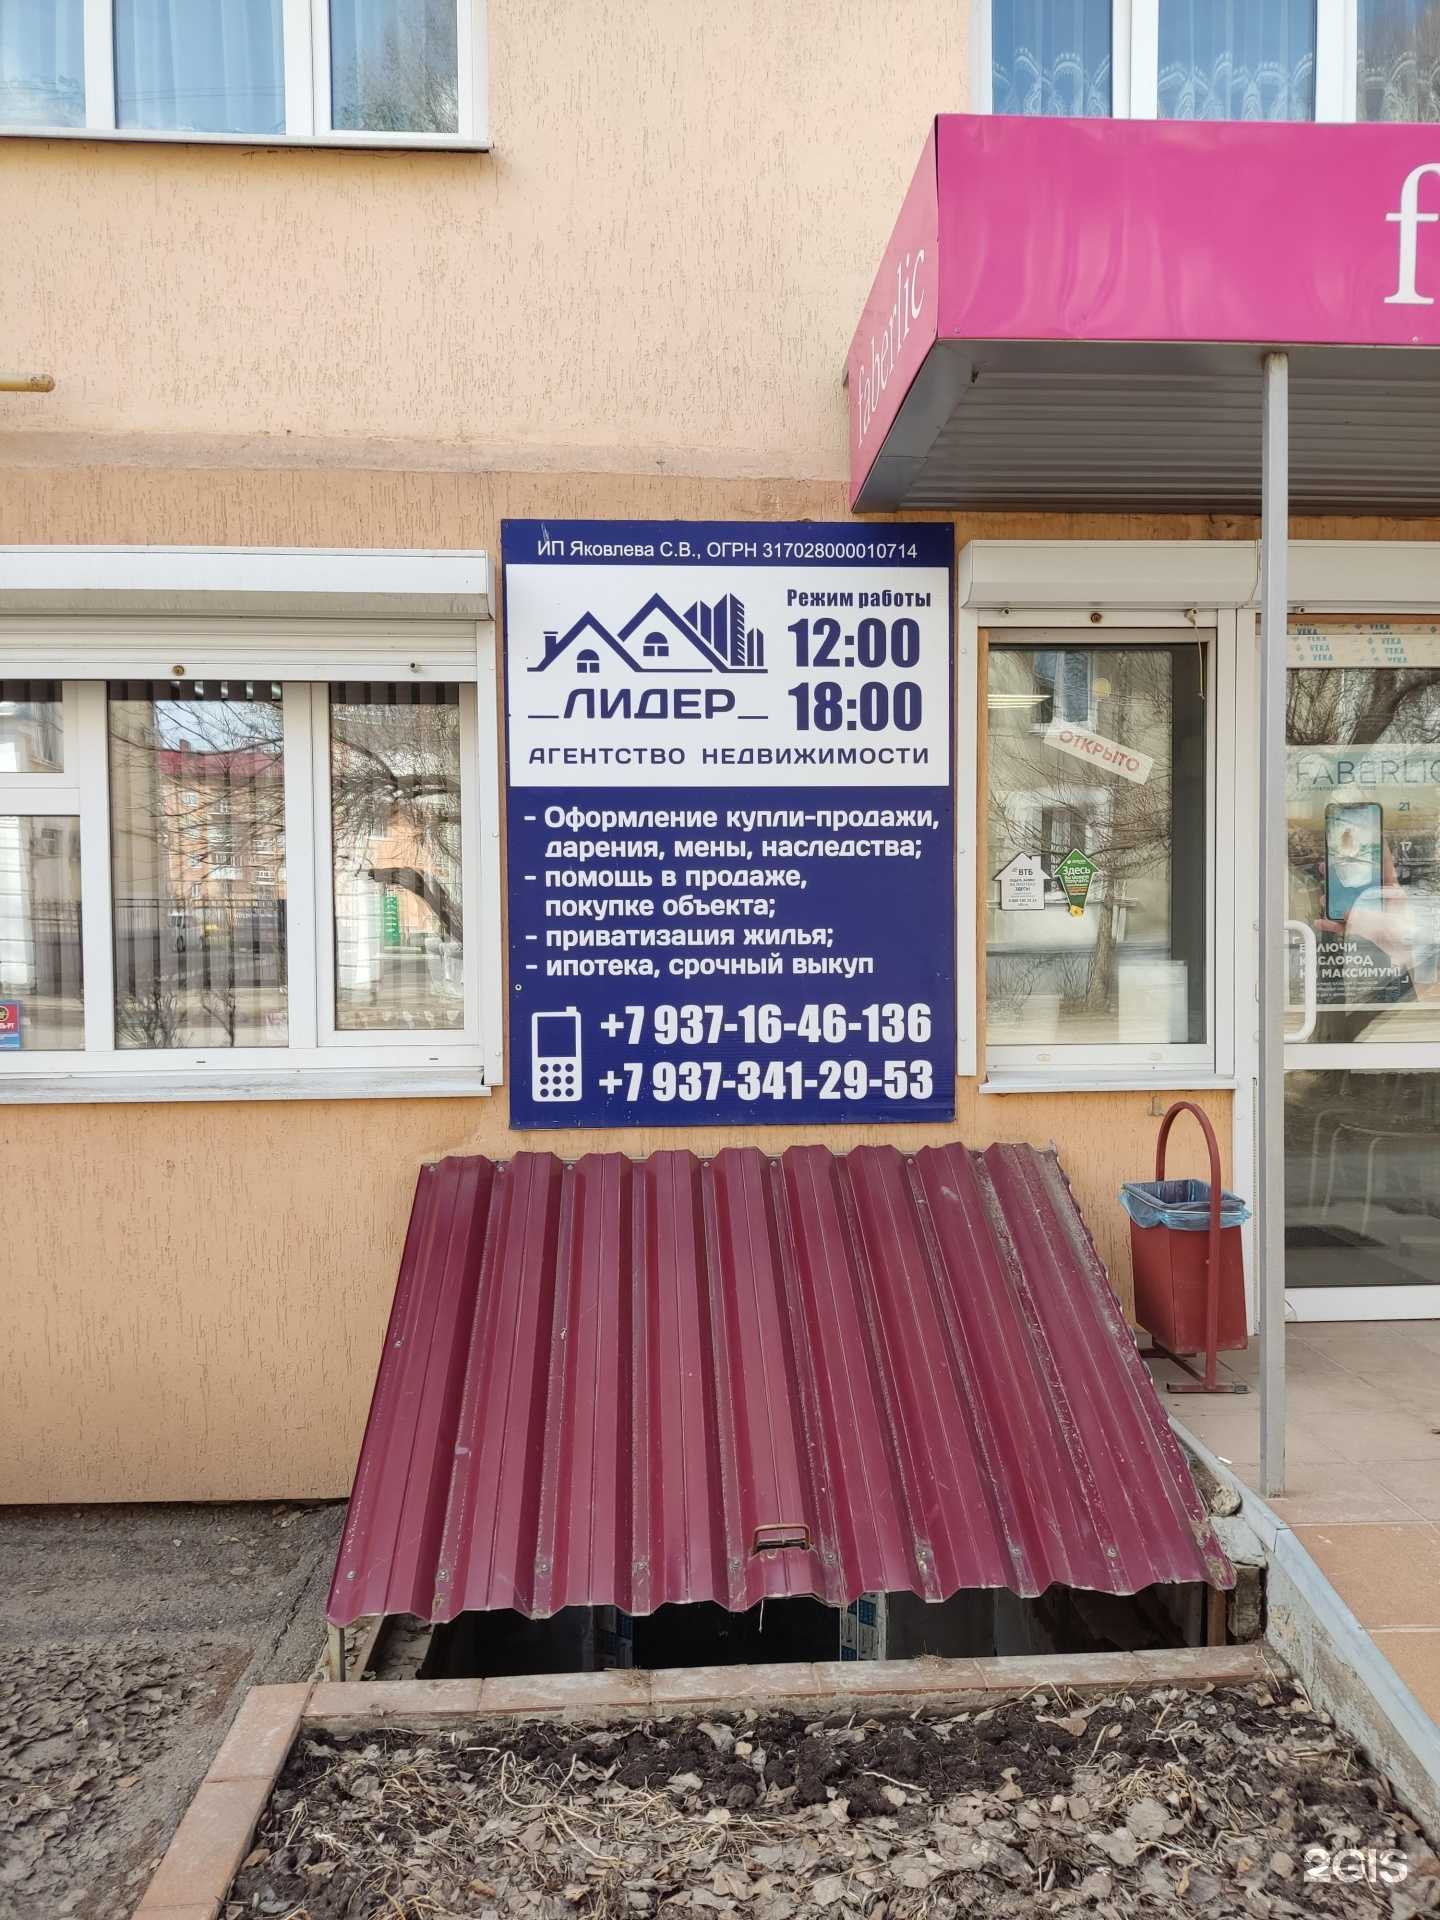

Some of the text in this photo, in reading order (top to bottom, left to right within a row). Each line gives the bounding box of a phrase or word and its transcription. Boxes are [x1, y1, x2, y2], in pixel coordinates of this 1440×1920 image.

[857, 248, 925, 449] faberlic
[537, 540, 918, 560] ИП Яковлева С.В., ОГРН 317028000010714
[787, 588, 931, 609] Режим работы
[787, 617, 920, 669] 12:00
[563, 688, 736, 720] ЛИДЕР
[787, 681, 923, 732] 18:00
[528, 747, 929, 765] АГЕНТСТВО НЕДВИЖИМОСТИ
[1059, 730, 1140, 772] ОТКРЫТО
[544, 805, 718, 833] Оформление
[726, 809, 939, 833] купли-продажи,
[544, 839, 922, 862] дарения, мены, наследства;
[545, 870, 653, 888] помощь
[661, 869, 677, 887] в
[685, 869, 807, 891] продаже,
[1062, 866, 1091, 876] Здесь
[545, 894, 776, 921] покупке объекта;
[546, 928, 735, 951] приватизация
[743, 927, 834, 948] жилья;
[1300, 942, 1357, 953] ВЛЮЧИ
[546, 958, 661, 979] ипотека,
[668, 952, 783, 980] срочный
[792, 957, 874, 979] выкуп
[1300, 955, 1374, 966] КСЛОРОД
[600, 1002, 932, 1045] +7 937-16-46-136
[598, 1059, 933, 1102] +7 937-341-29-53
